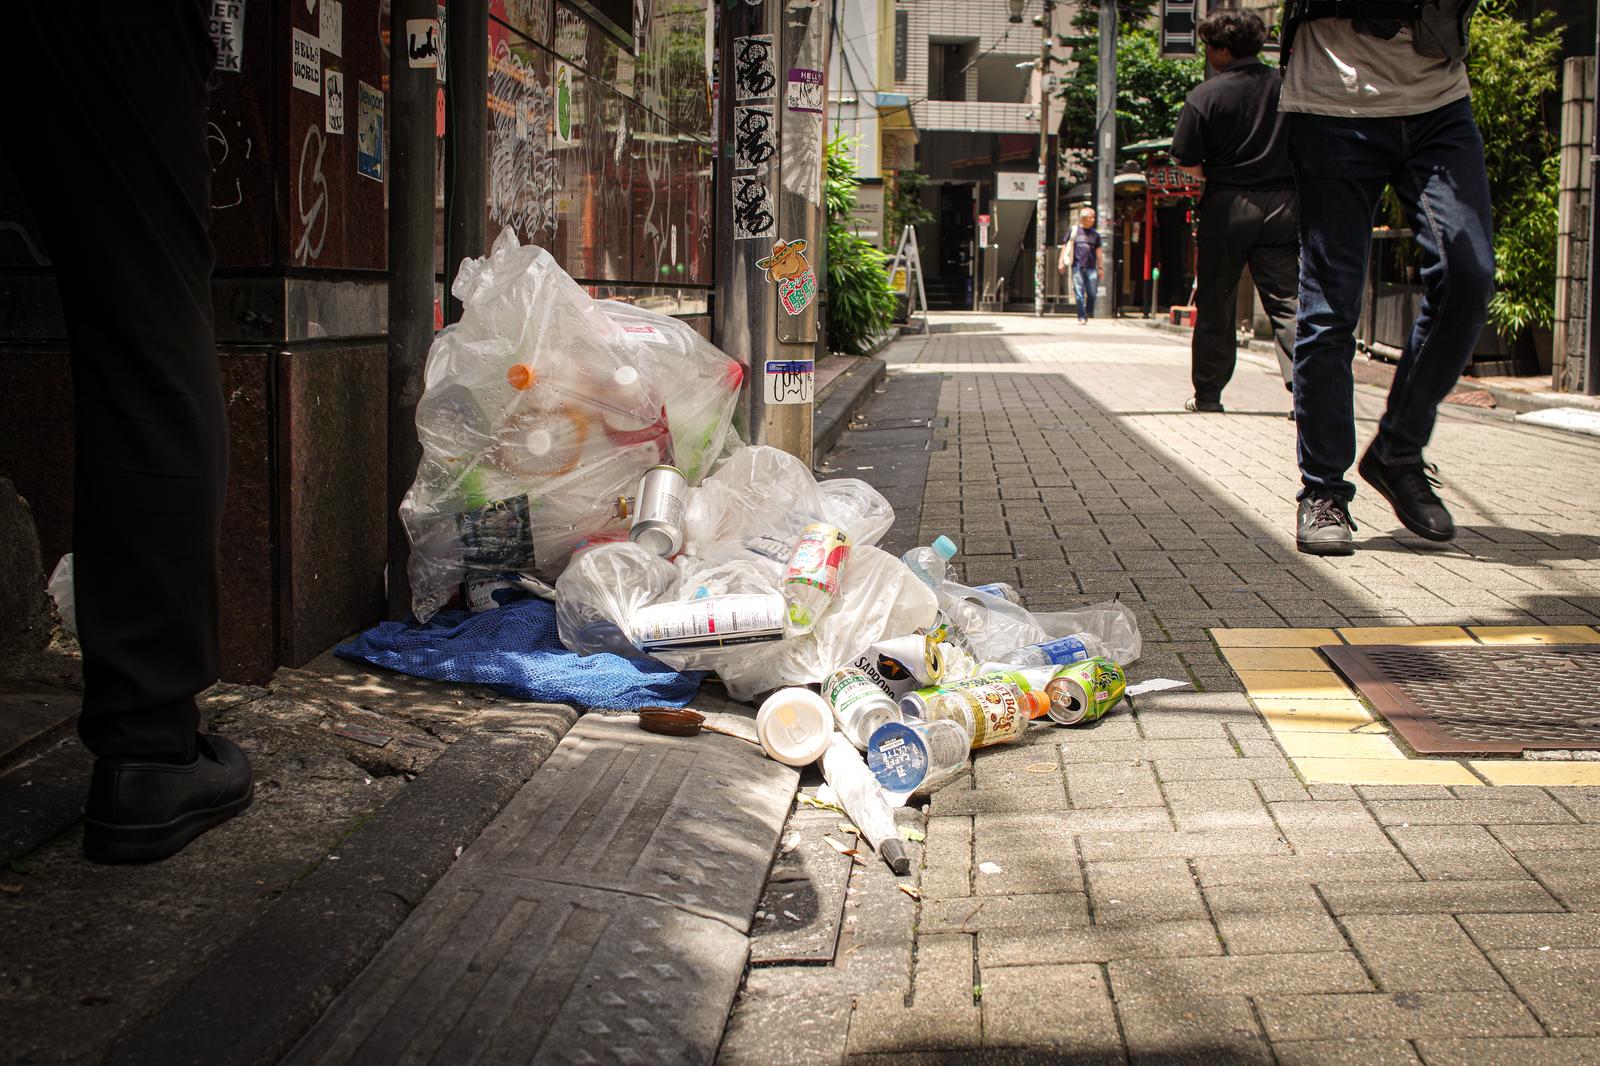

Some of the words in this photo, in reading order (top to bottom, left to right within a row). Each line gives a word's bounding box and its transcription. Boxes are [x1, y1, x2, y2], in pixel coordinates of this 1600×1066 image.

[294, 39, 319, 65] HELLO
[293, 61, 319, 84] WORLD
[359, 84, 384, 111] Newport
[881, 746, 909, 760] LATTE
